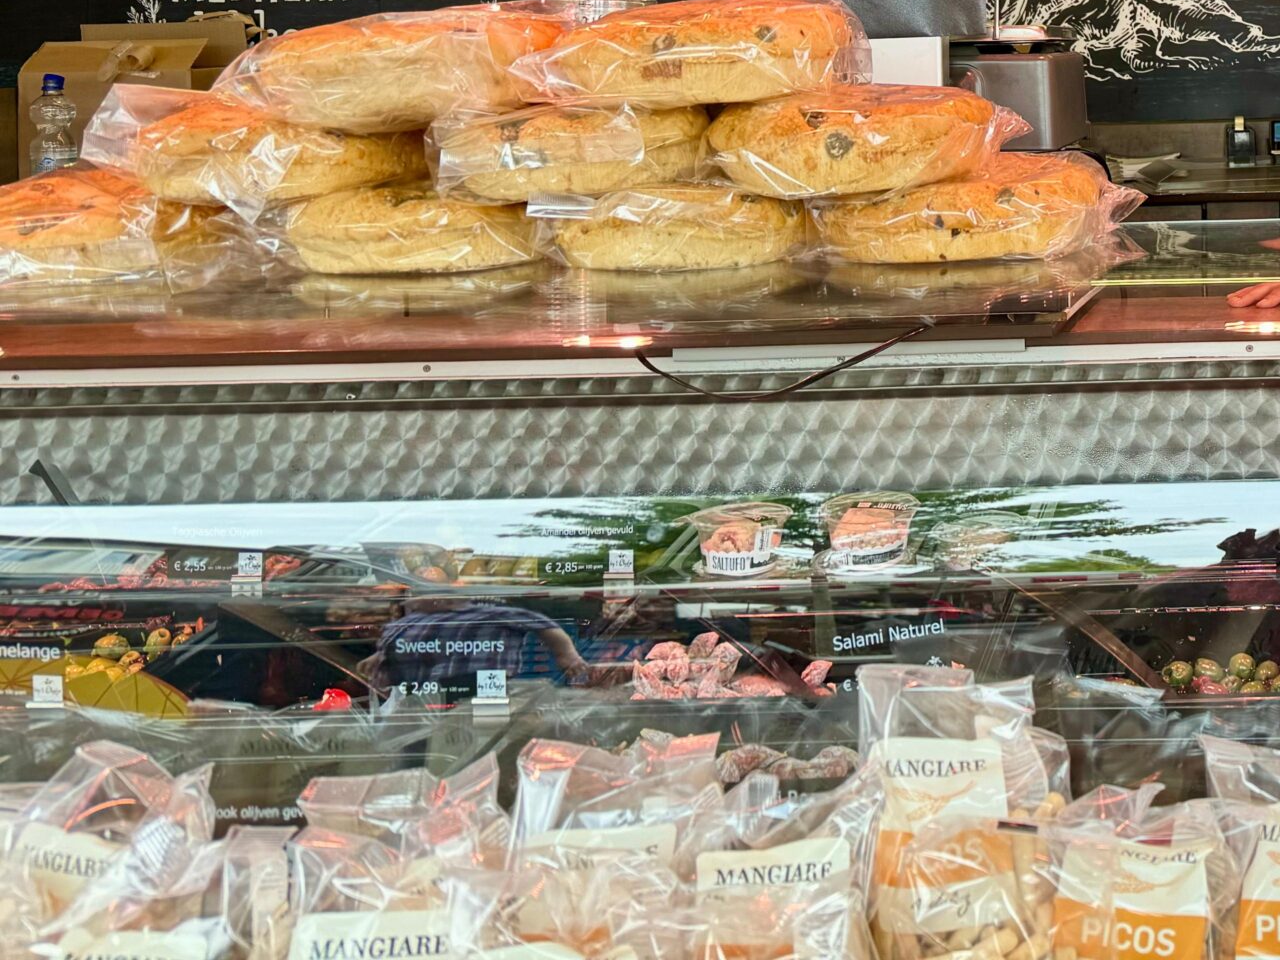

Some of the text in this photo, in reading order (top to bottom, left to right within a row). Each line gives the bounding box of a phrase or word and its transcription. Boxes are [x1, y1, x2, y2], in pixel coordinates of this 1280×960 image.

[607, 525, 634, 537] gevuld
[174, 561, 182, 572] €
[545, 562, 553, 573] €
[555, 561, 578, 574] 2,85
[832, 618, 945, 652] Salami Naturel
[395, 638, 505, 656] Sweet peppers
[399, 684, 408, 695] €
[411, 682, 439, 696] 2,99
[1081, 917, 1177, 957] PICOS
[309, 933, 450, 960] MANGIARE
